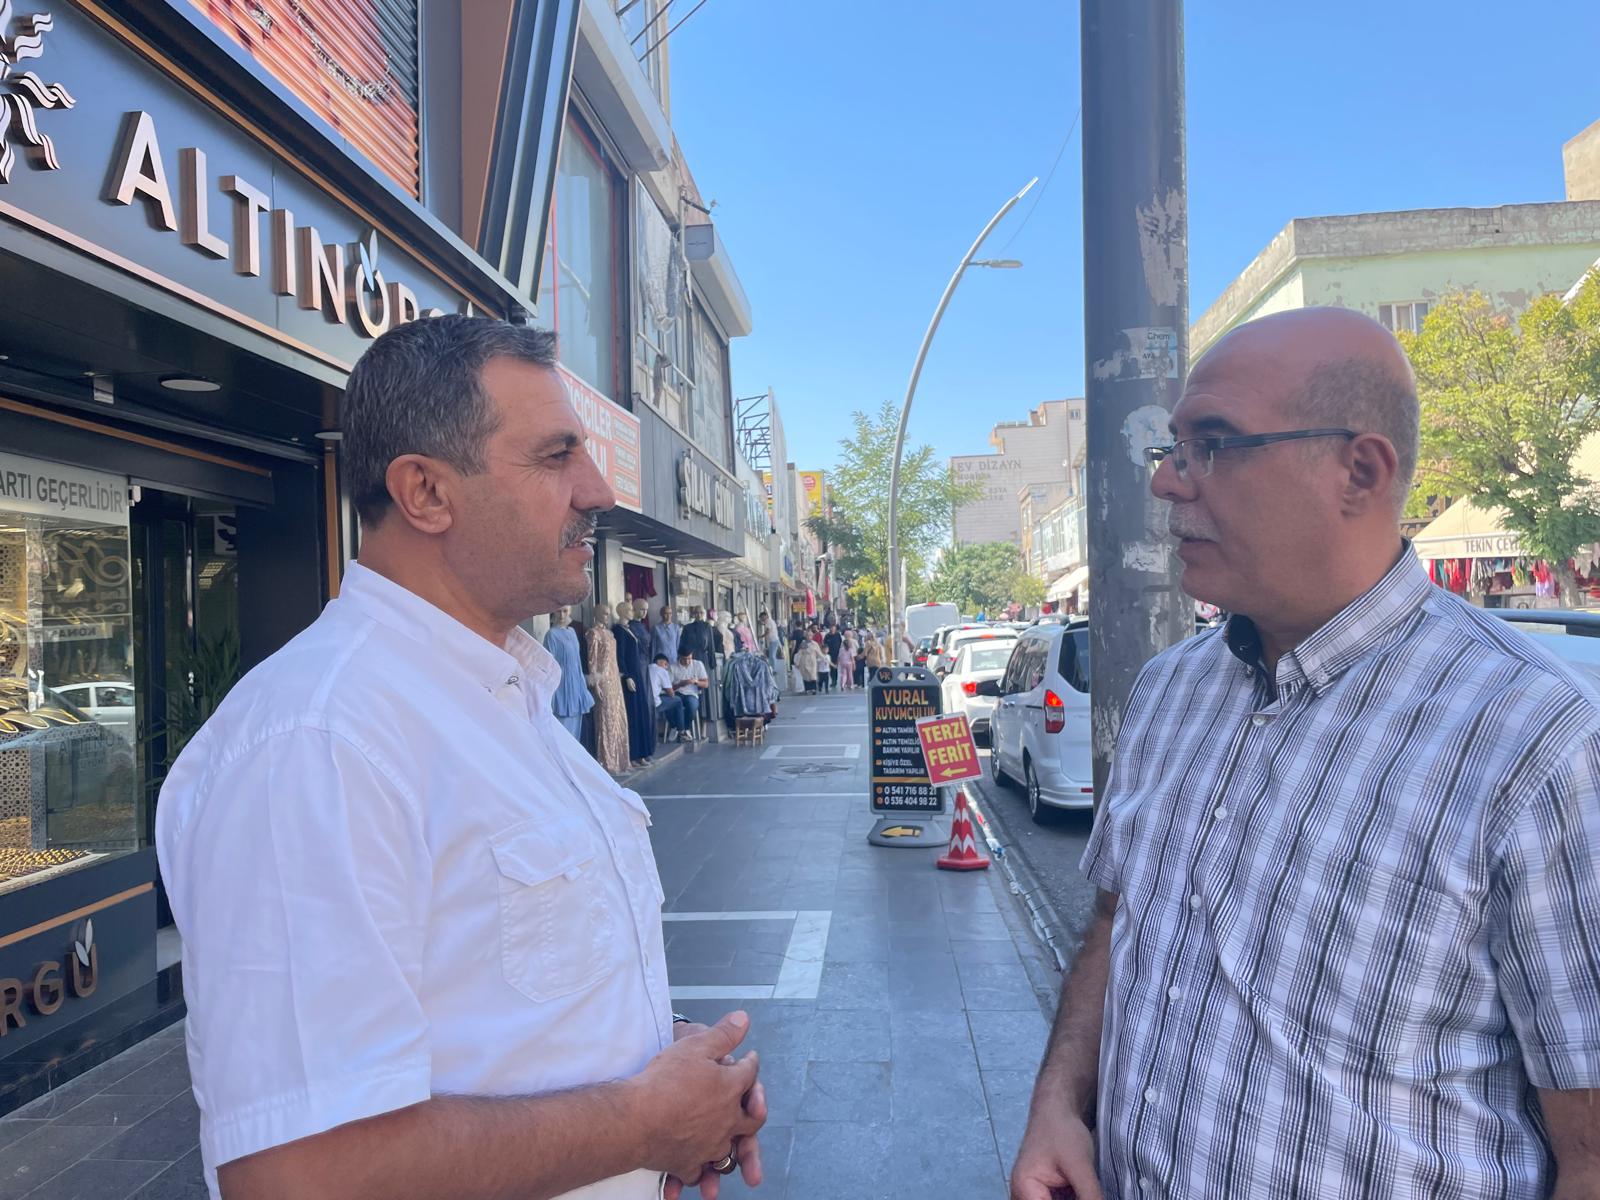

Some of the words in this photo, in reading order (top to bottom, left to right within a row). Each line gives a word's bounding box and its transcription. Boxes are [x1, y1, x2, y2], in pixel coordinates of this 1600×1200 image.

[978, 459, 1022, 471] DİZAYN
[37, 476, 123, 513] GEÇERLİDİR
[883, 689, 929, 705] VURAL
[922, 717, 968, 743] TERZİ
[927, 741, 972, 767] FERİT
[884, 786, 890, 794] 0
[891, 786, 904, 795] 541
[884, 797, 890, 805] 0
